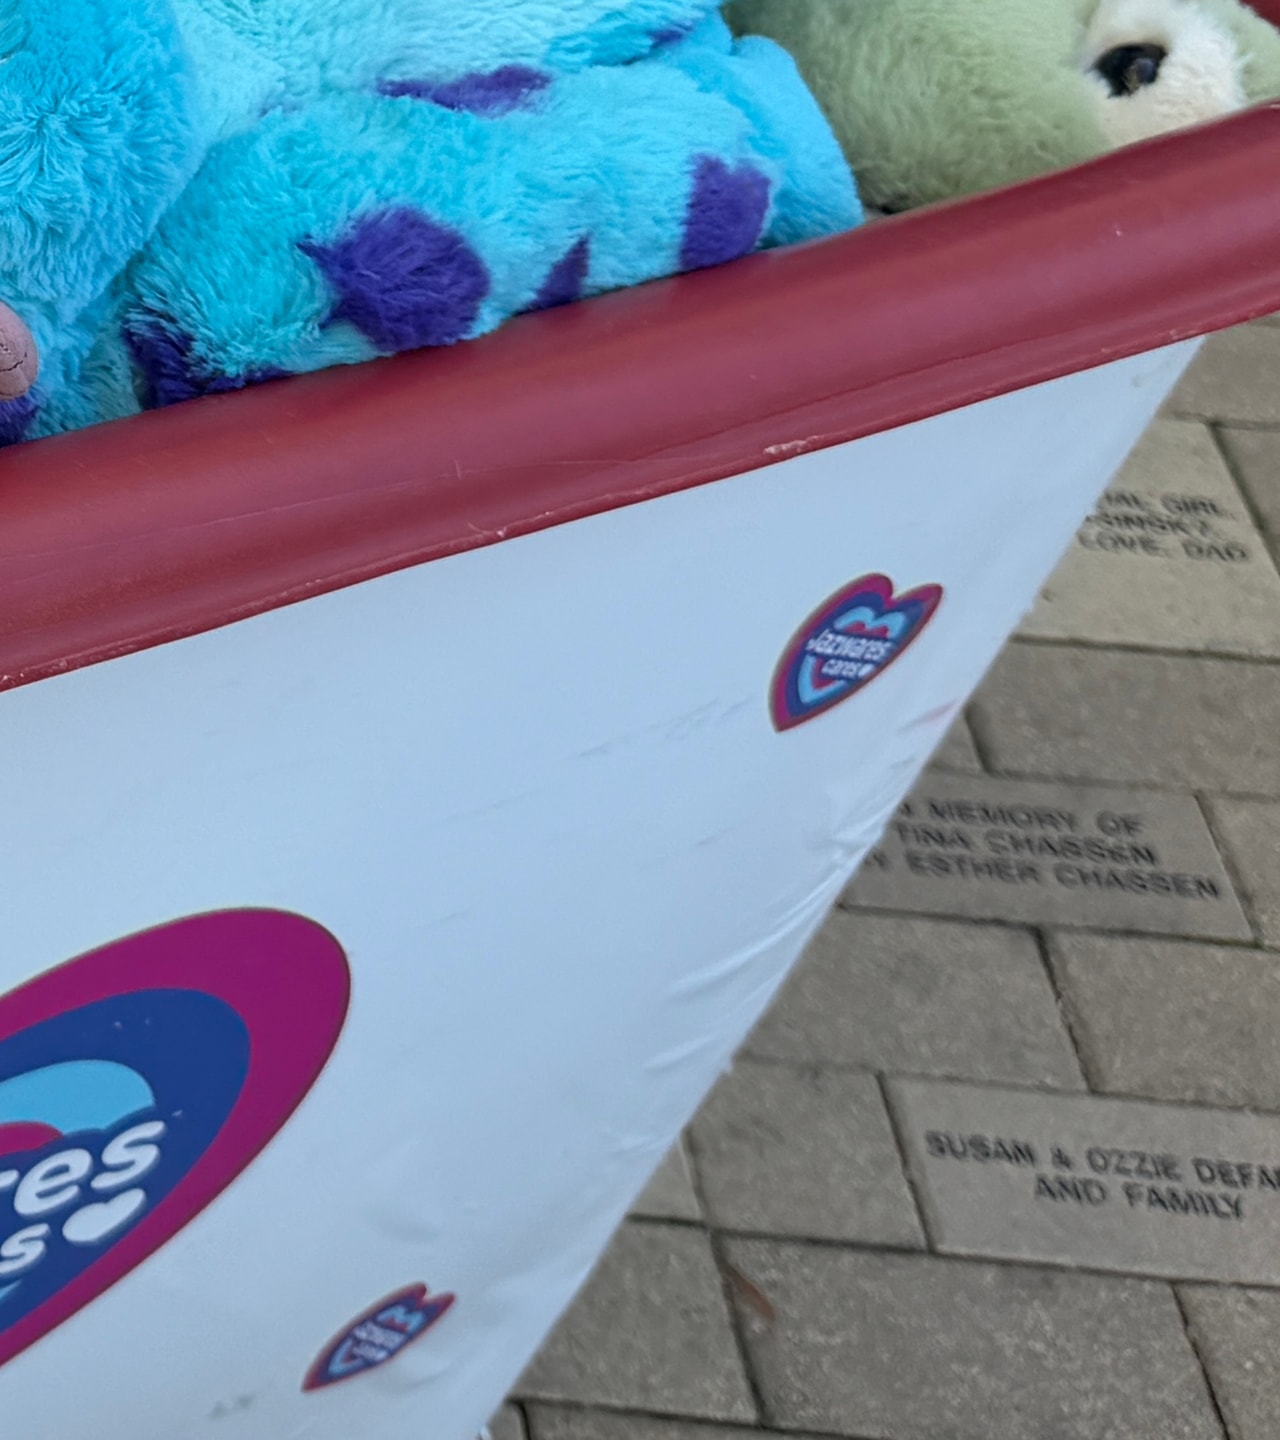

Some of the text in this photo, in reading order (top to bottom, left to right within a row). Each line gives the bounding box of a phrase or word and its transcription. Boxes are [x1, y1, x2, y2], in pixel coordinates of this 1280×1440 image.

[926, 799, 1078, 832] MEMORY
[1096, 811, 1145, 837] OF
[985, 830, 1156, 866] CHASSEN
[904, 848, 1041, 884] ESTHER
[1053, 863, 1220, 901] CHASSEN
[925, 1130, 1037, 1167] SUSAN
[1050, 1144, 1073, 1171] &
[1085, 1146, 1183, 1182] OZZIE
[1035, 1172, 1244, 1221] AND FAMILY
